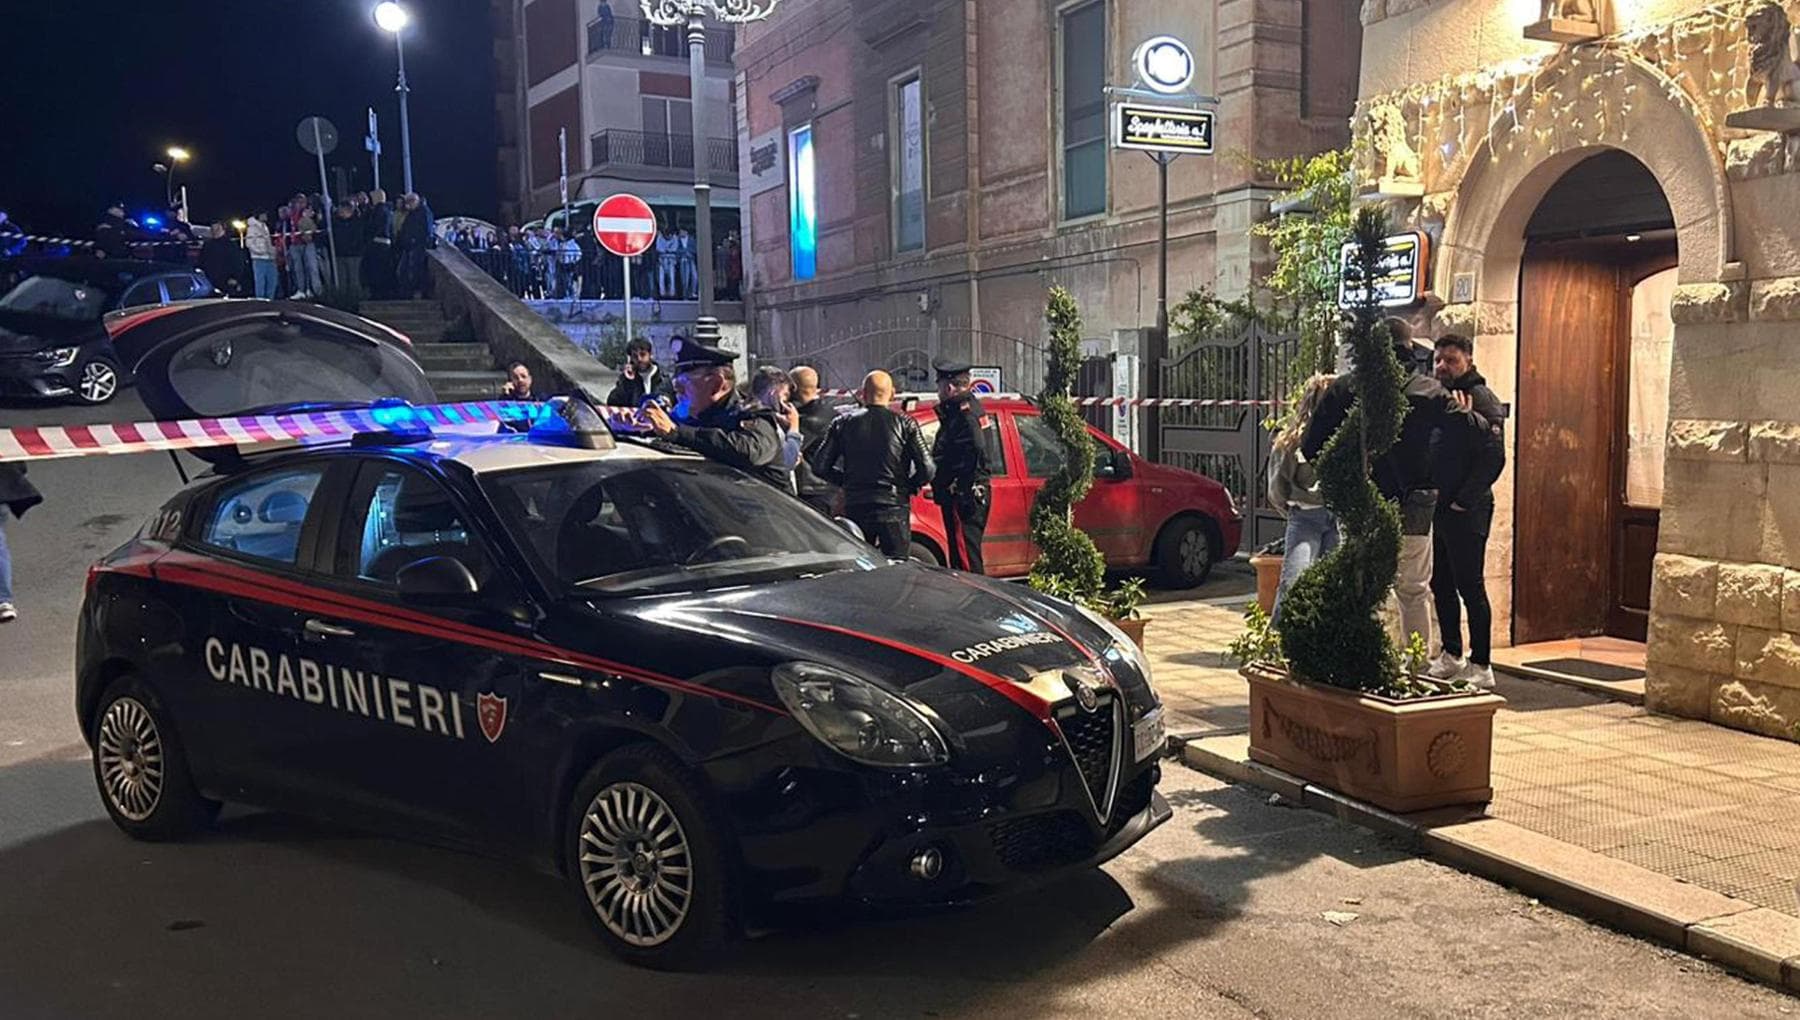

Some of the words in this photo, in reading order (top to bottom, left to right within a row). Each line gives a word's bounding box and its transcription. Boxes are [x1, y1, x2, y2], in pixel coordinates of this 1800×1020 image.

[1456, 278, 1469, 297] 20
[951, 631, 1063, 663] CARABINIERI
[205, 637, 465, 739] CARABINIERI
